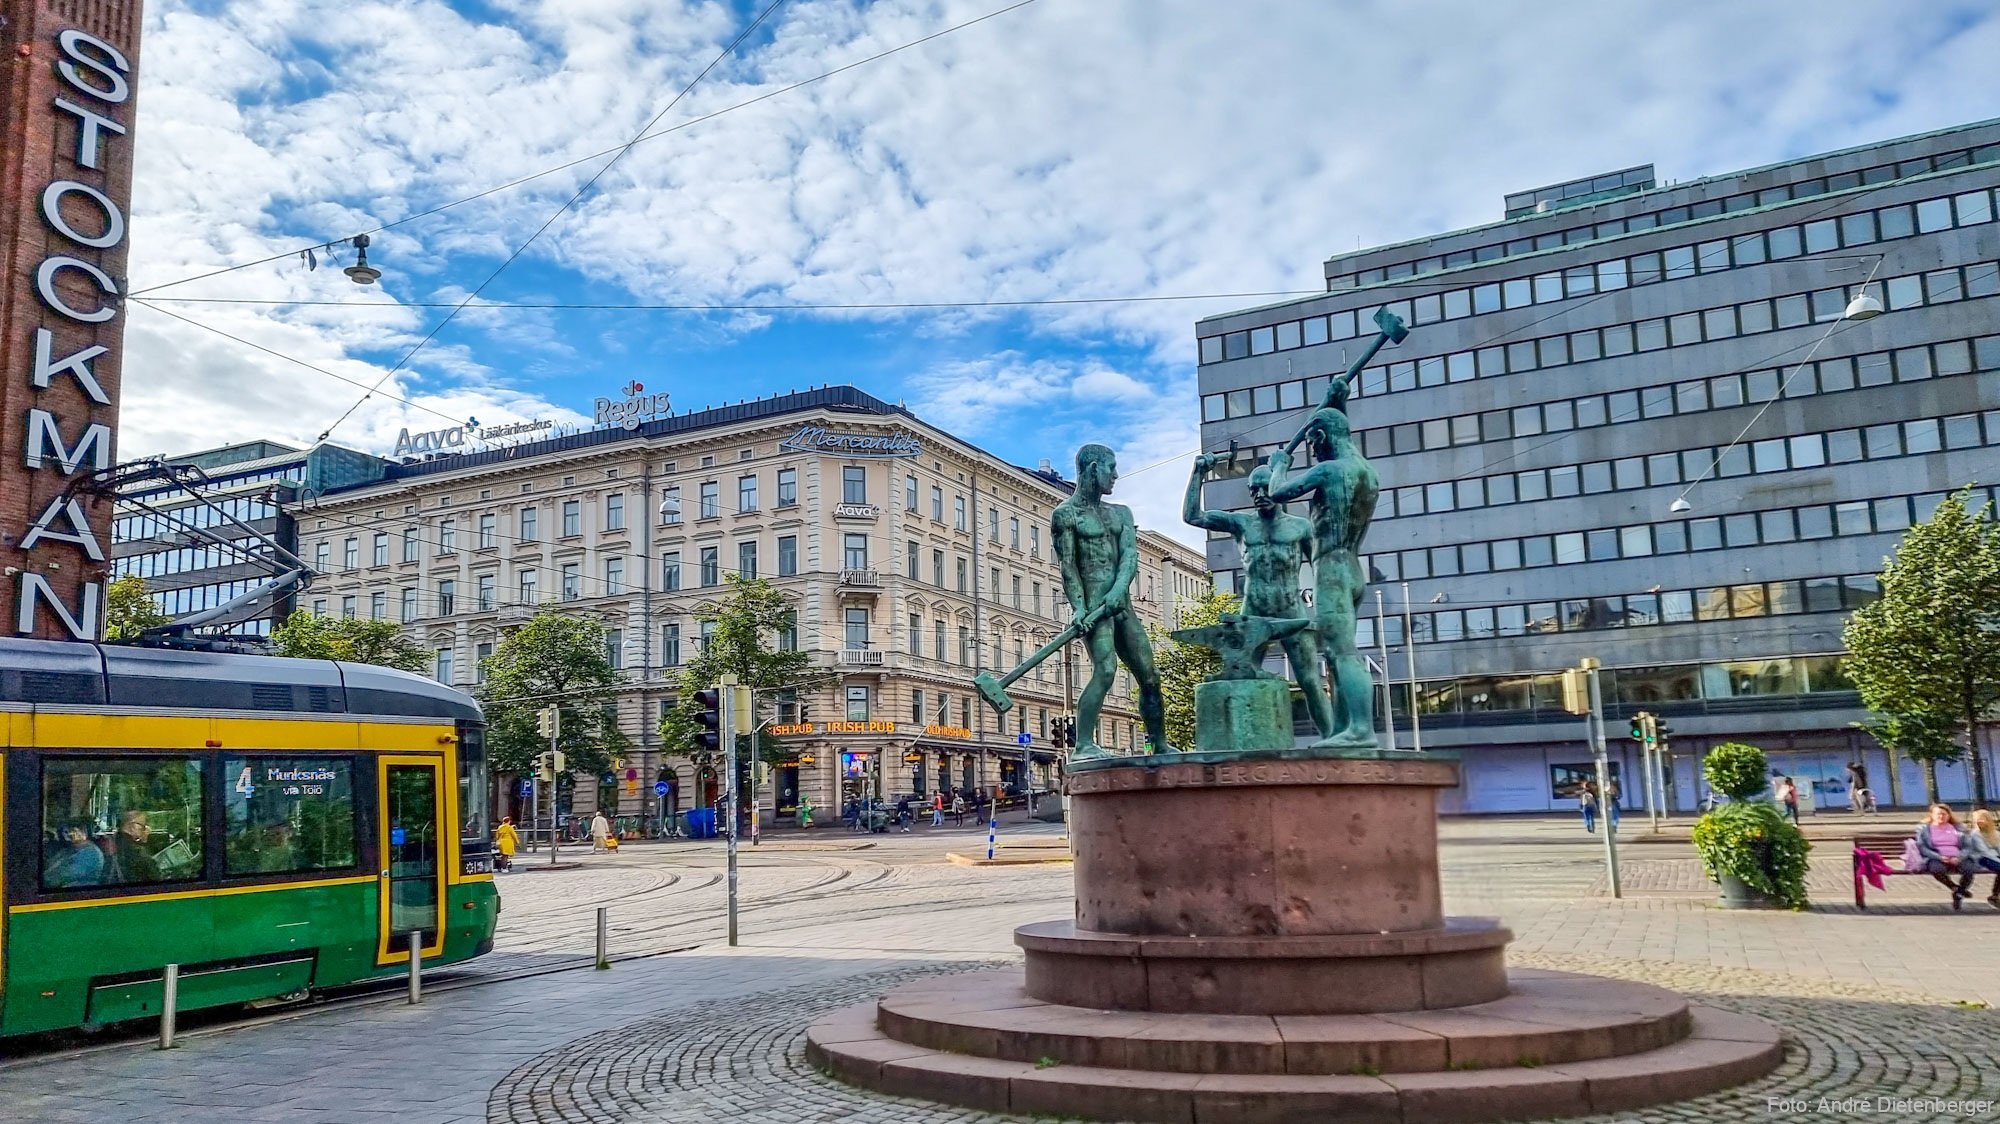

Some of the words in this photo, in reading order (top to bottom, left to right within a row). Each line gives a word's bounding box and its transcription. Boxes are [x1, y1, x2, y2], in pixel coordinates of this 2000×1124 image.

[594, 392, 671, 431] Regus
[480, 418, 553, 440] Lääkärikeskus
[394, 425, 465, 457] Aava
[784, 426, 923, 455] Mercantile
[834, 503, 873, 517] Aava
[792, 722, 814, 734] PUB
[827, 722, 865, 732] IRISH
[869, 721, 896, 732] PUB
[235, 766, 255, 798] 4
[268, 767, 335, 780] Munksnäs
[282, 786, 300, 796] via
[524, 780, 531, 791] P
